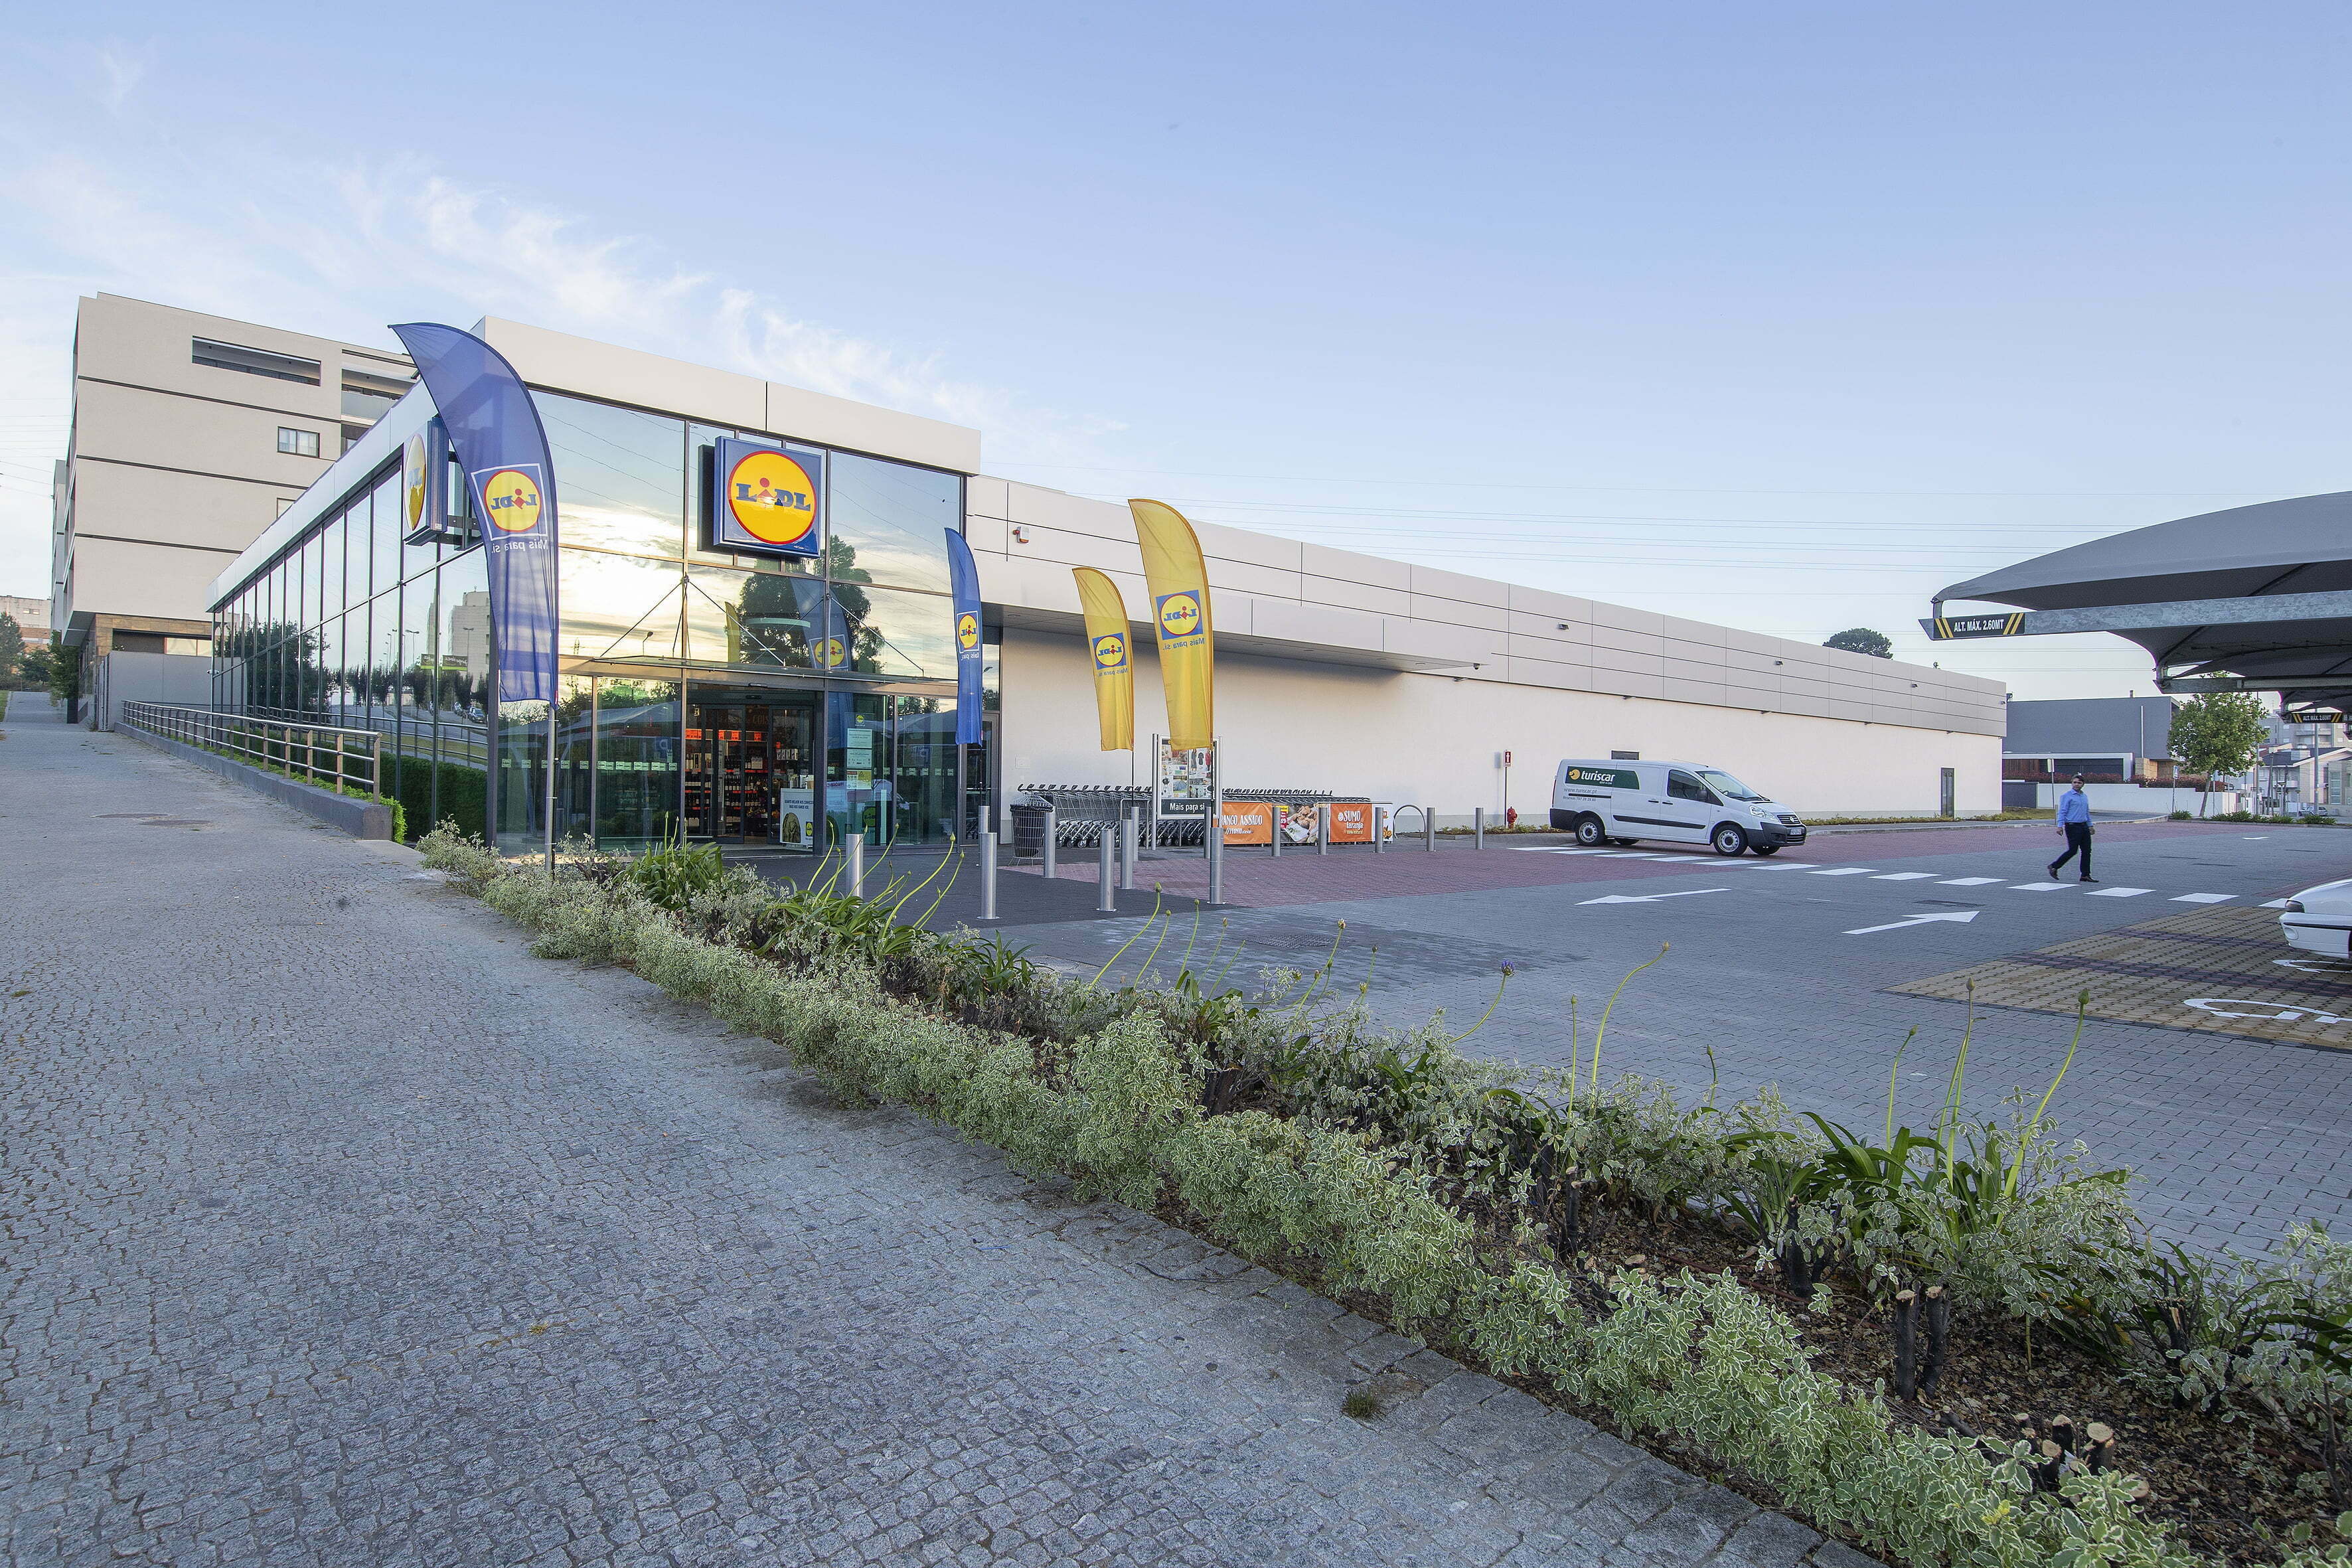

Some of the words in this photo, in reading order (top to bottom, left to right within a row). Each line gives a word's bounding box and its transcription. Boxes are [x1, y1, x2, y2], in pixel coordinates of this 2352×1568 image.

[736, 478, 811, 511] LIDL
[1954, 621, 1966, 632] ALT.
[1967, 619, 1982, 631] MÁX.
[1983, 619, 2004, 630] 2.60MT
[1581, 770, 1615, 782] turiscar
[1186, 804, 1198, 813] para
[1221, 815, 1238, 826] RANGO
[1240, 815, 1263, 826] ASSADO
[1344, 810, 1361, 822] SUMO
